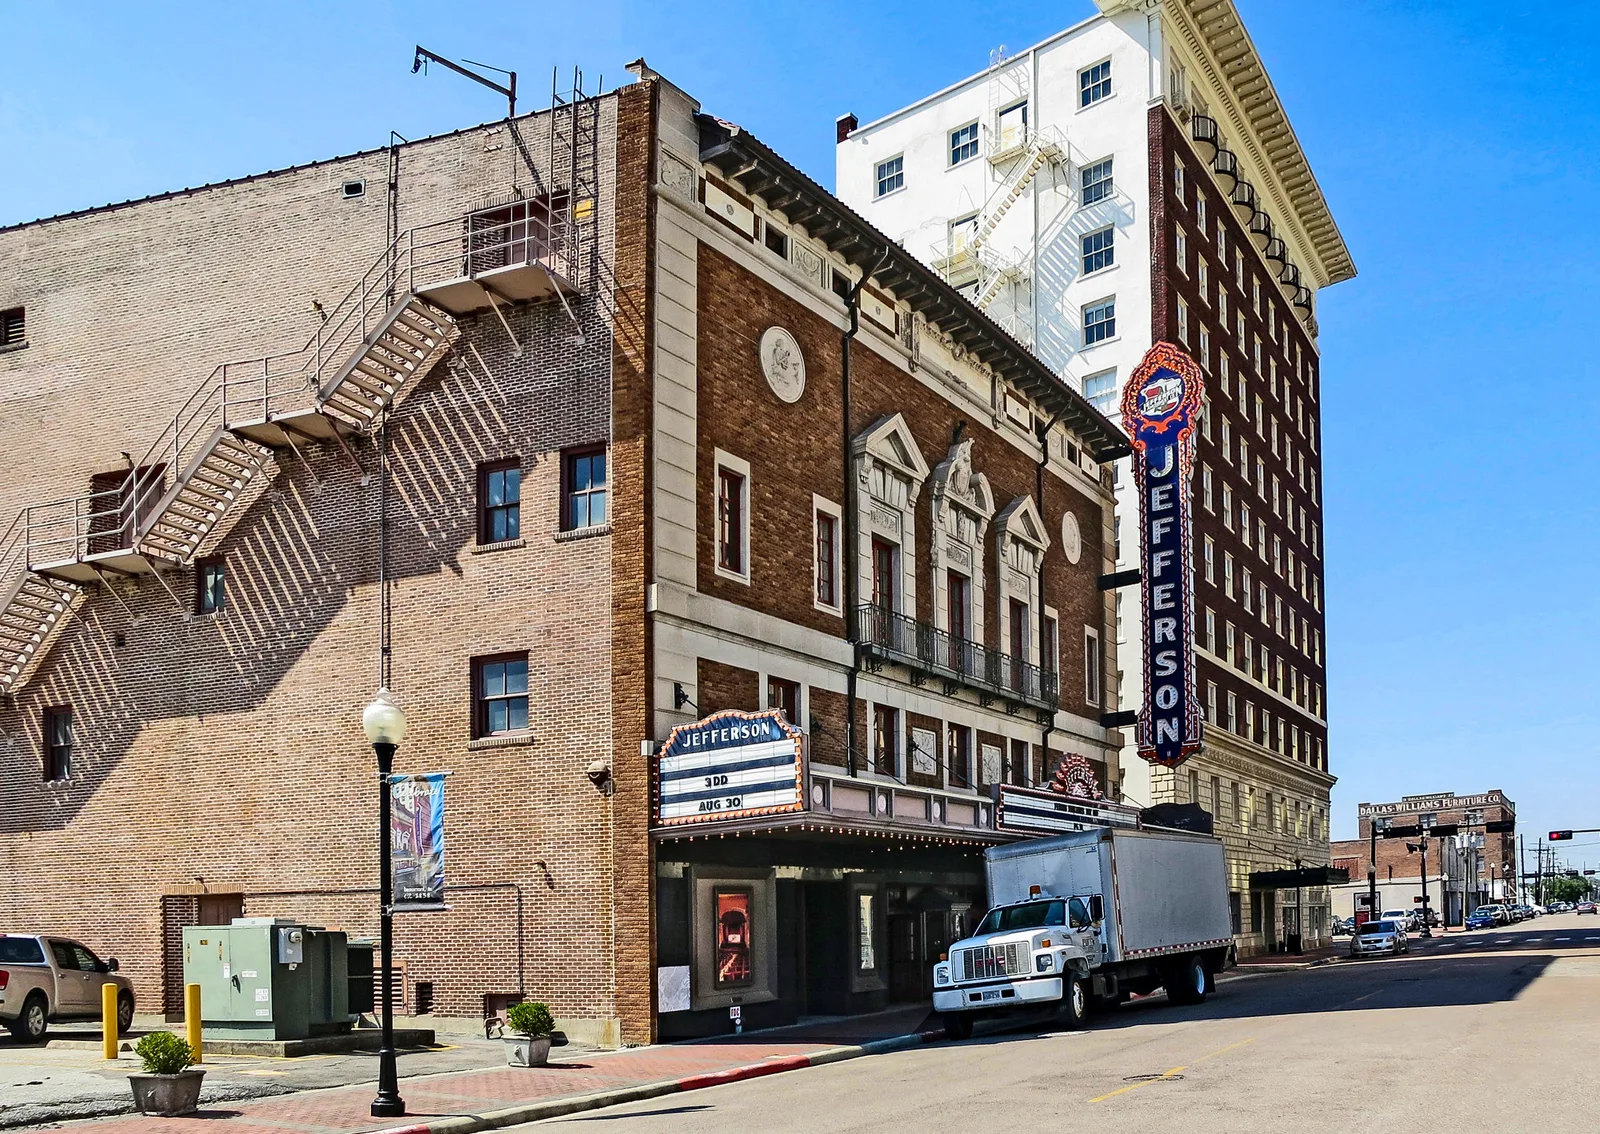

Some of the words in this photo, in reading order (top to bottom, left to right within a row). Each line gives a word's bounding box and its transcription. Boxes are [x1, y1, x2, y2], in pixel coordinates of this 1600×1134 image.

[1149, 445, 1180, 746] JEFFERSON
[682, 721, 771, 748] JEFFERSON
[704, 775, 729, 787] 3DD
[698, 799, 721, 812] AUG
[725, 797, 741, 808] 30
[1442, 796, 1487, 808] FURNITURE
